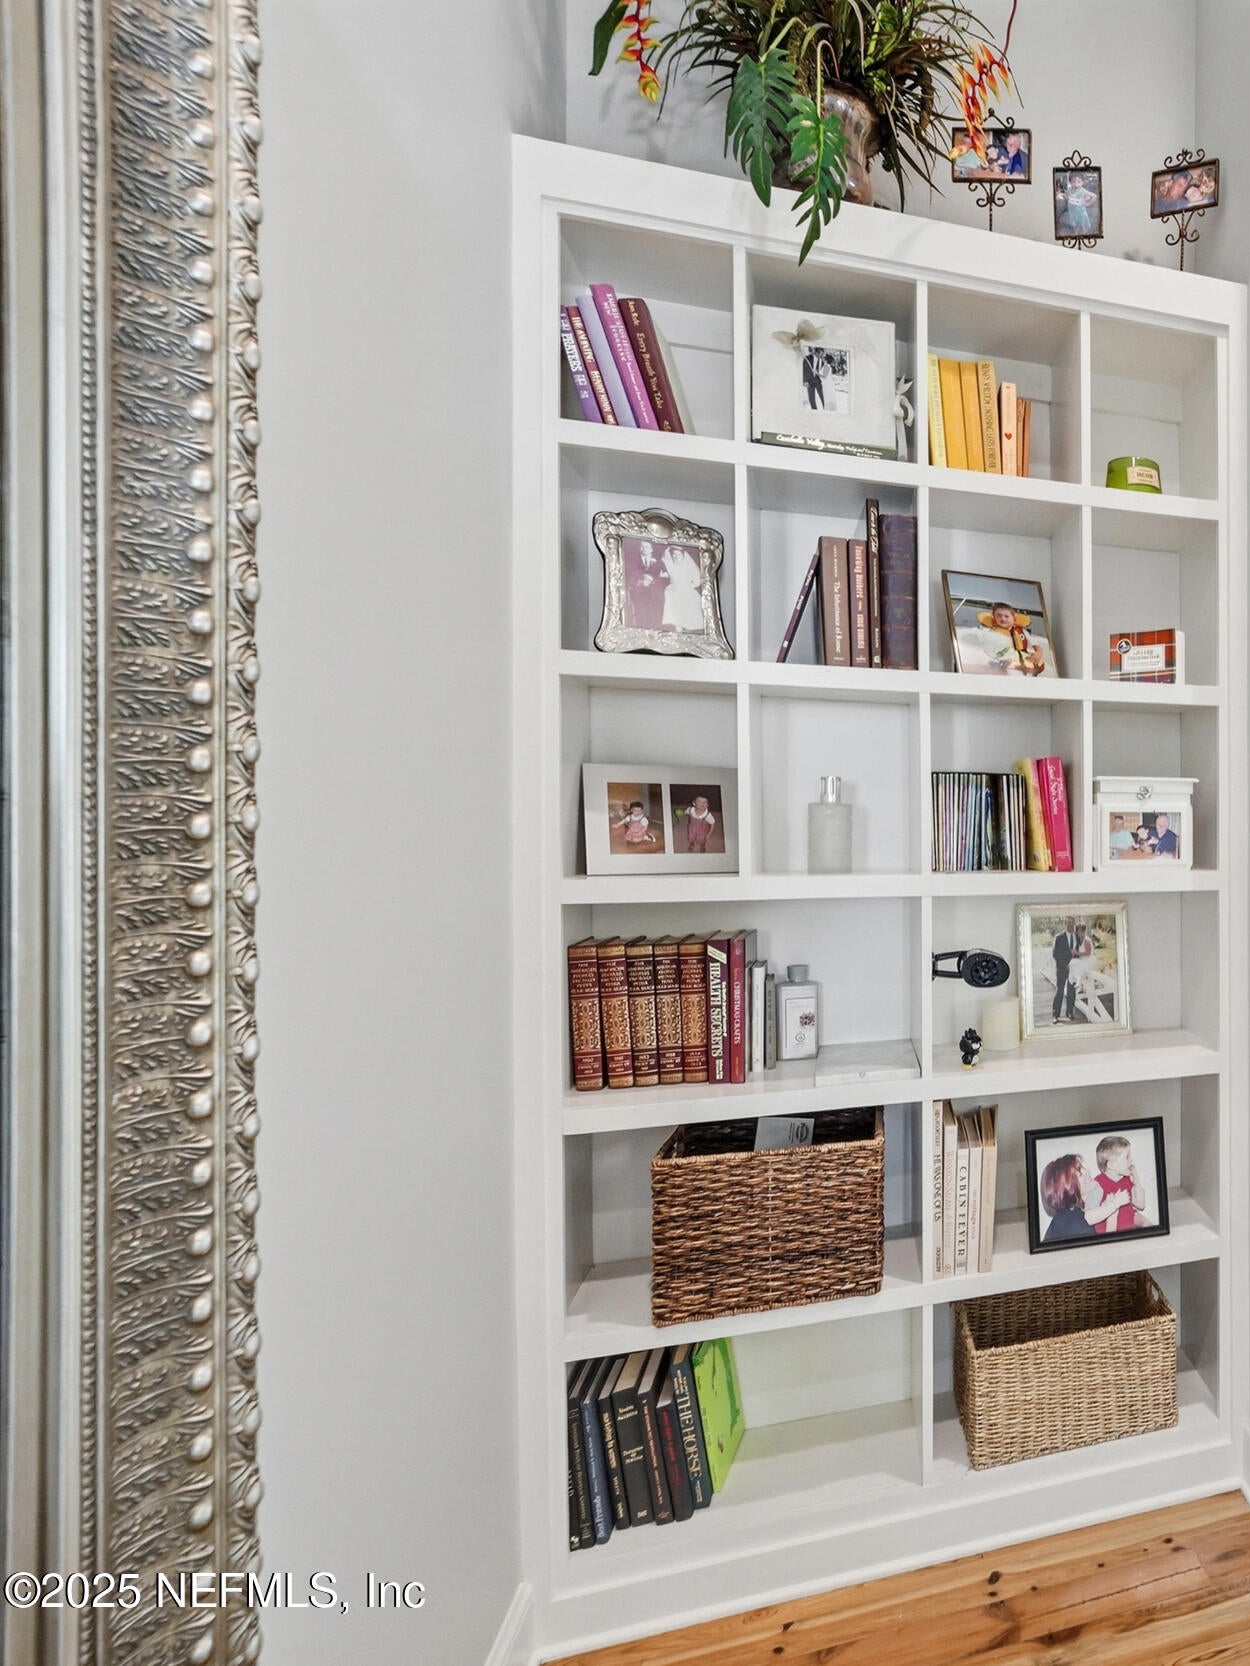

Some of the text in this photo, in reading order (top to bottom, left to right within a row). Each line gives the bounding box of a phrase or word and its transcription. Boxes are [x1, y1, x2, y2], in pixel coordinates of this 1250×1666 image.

[709, 962, 722, 1006] HEALTH
[711, 1007, 724, 1057] SECRETS
[957, 1166, 969, 1256] CABIN FEVER
[677, 1395, 695, 1428] THE
[682, 1426, 703, 1478] HORSE
